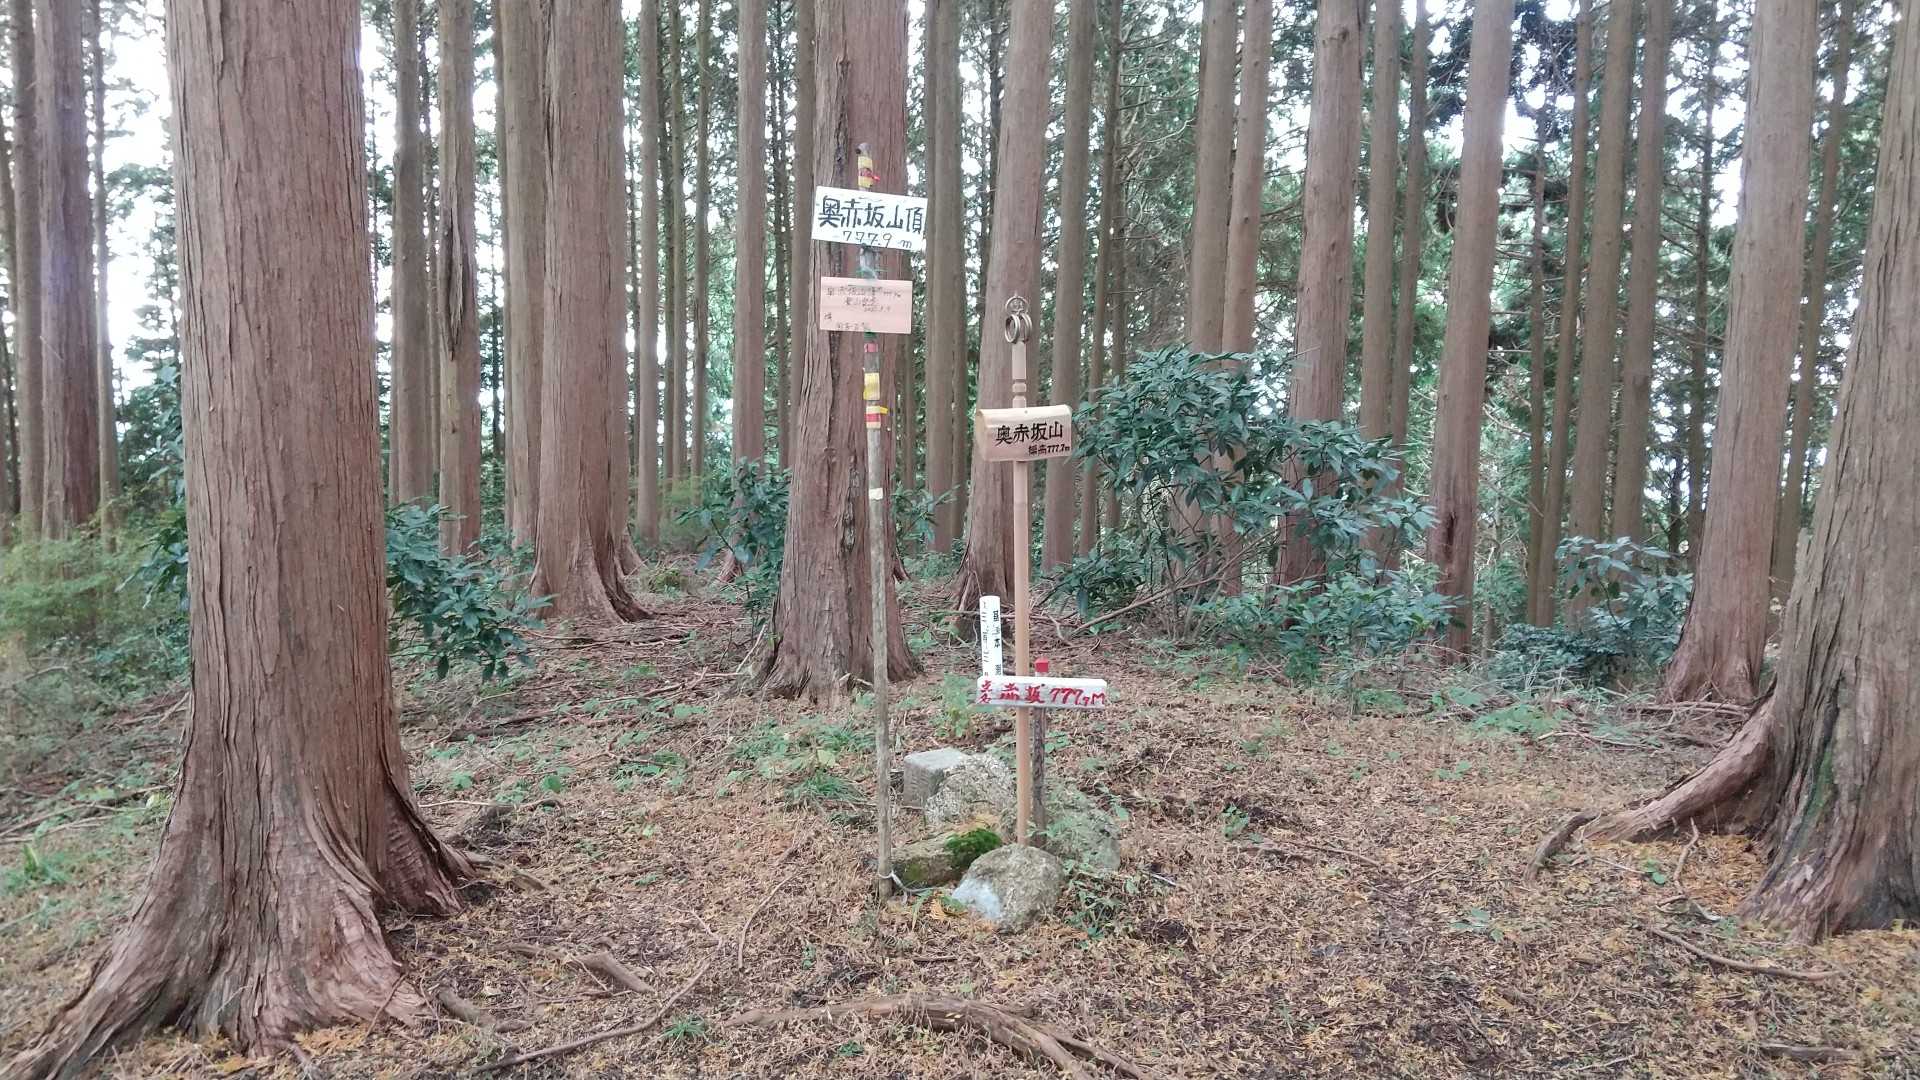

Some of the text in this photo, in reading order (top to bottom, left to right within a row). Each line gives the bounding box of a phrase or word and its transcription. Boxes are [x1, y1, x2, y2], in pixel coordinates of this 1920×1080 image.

[818, 195, 924, 235] 奥赤坂山頂
[995, 422, 1063, 446] 奥赤坂山
